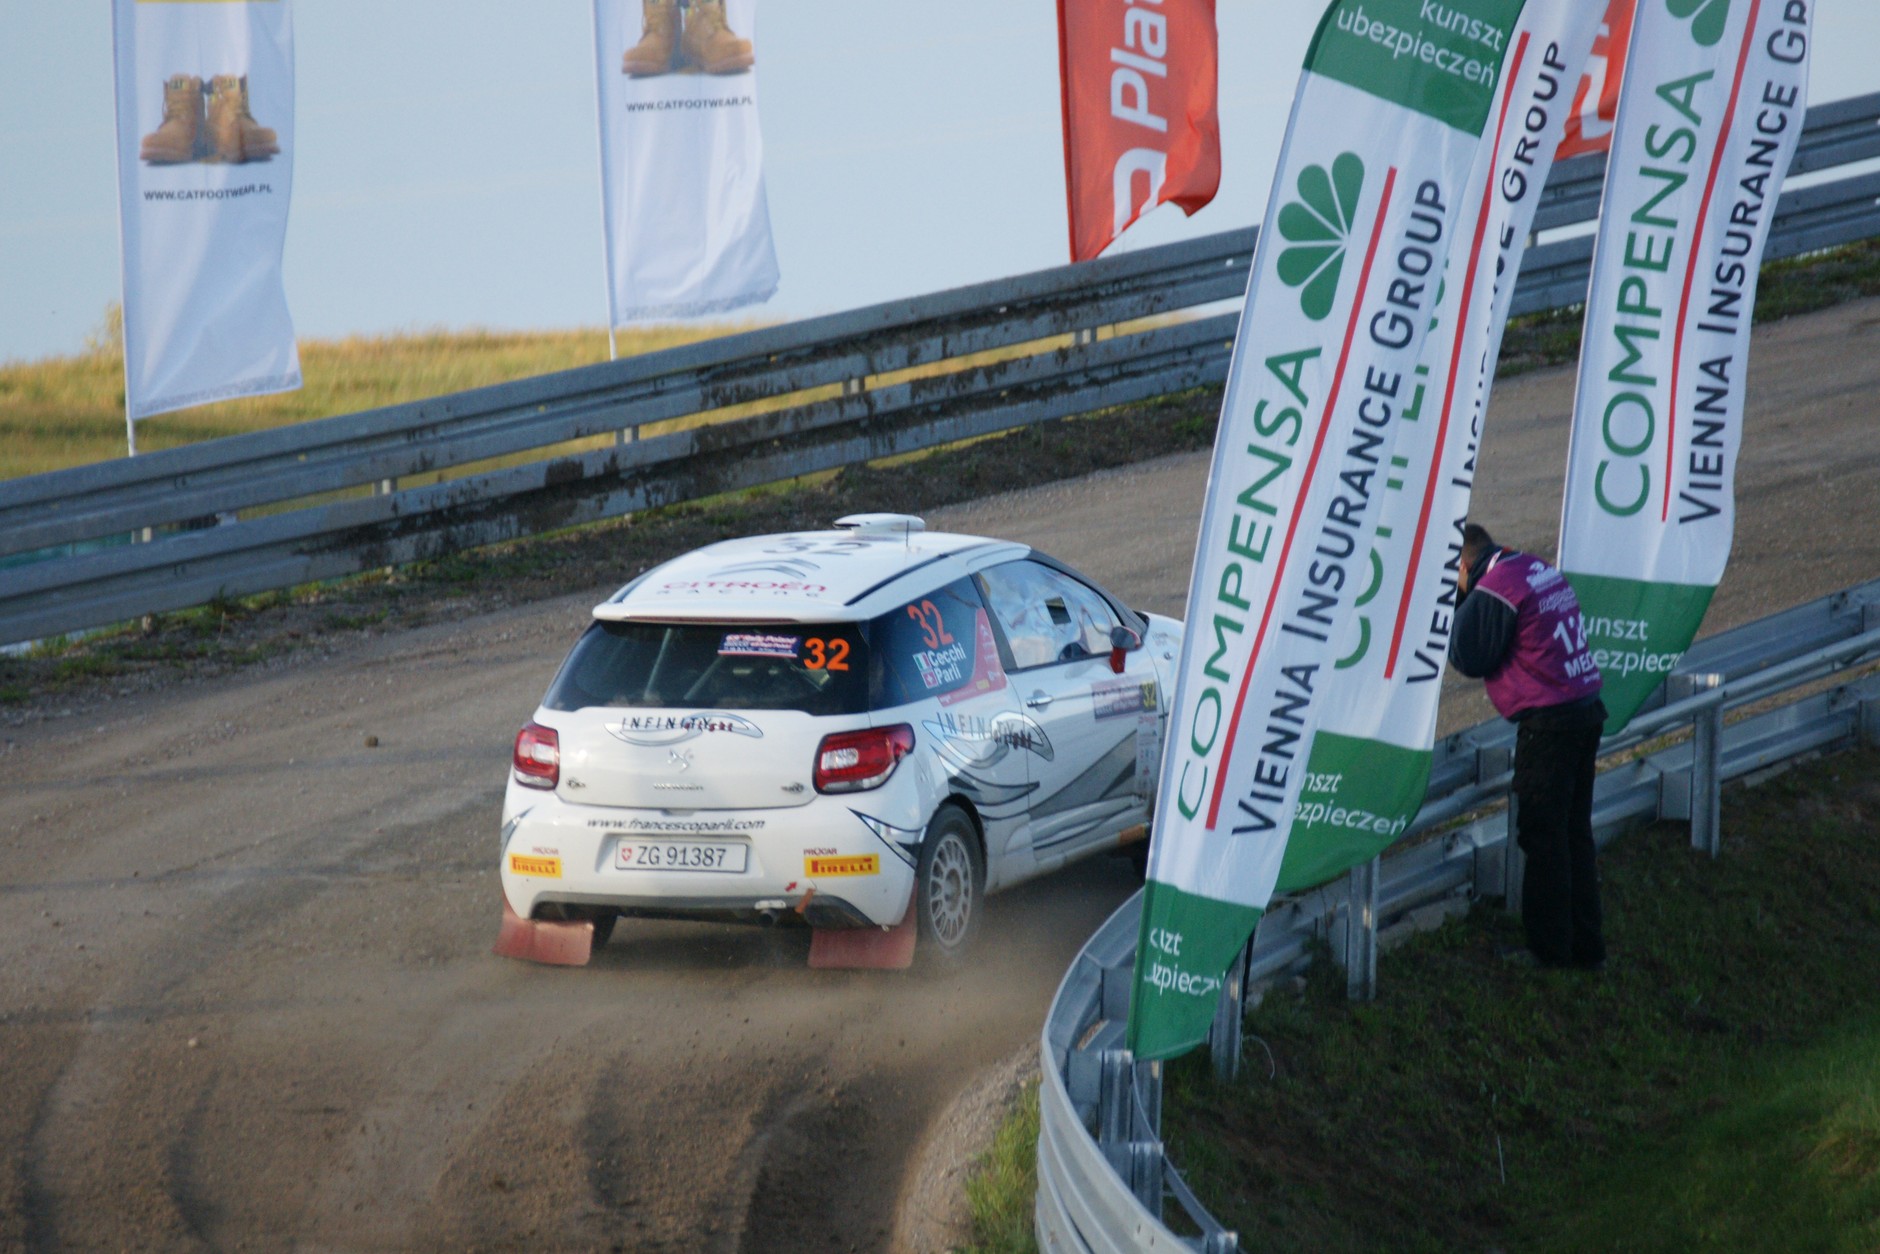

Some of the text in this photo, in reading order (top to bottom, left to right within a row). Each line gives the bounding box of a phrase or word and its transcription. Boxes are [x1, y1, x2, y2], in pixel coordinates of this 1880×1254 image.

[1420, 0, 1503, 52] kunszt
[1337, 7, 1495, 89] ubezpieczeń
[1111, 0, 1167, 132] Pla
[626, 95, 753, 113] WWW.CATFOOTWEAR.PL
[1501, 41, 1567, 203] GROUP
[143, 183, 272, 201] WWW.CATFOOTWEAR.PL
[1696, 80, 1799, 336] INSURANCE
[1594, 69, 1715, 517] COMPENSA
[1678, 355, 1733, 525] VIENNA
[1231, 662, 1321, 836] VIENNA
[1281, 364, 1402, 643] INSURANCE
[1369, 179, 1447, 350] GROUP
[1177, 345, 1322, 822] COMPENSA
[906, 599, 954, 650] 32
[1586, 615, 1649, 642] unszt
[803, 636, 851, 672] 32
[927, 642, 967, 667] Cecchi
[1564, 650, 1598, 680] MED
[1593, 646, 1685, 680] ezpiecz
[934, 663, 962, 685] Parli
[621, 716, 713, 730] INFINITY
[1301, 770, 1343, 794] nszt
[587, 818, 766, 834] www.francescoparli.com
[1293, 799, 1408, 837] ezpieczeń
[511, 855, 557, 875] PIRELLI
[636, 845, 727, 868] ZG 91387
[810, 856, 873, 874] PIRELLI
